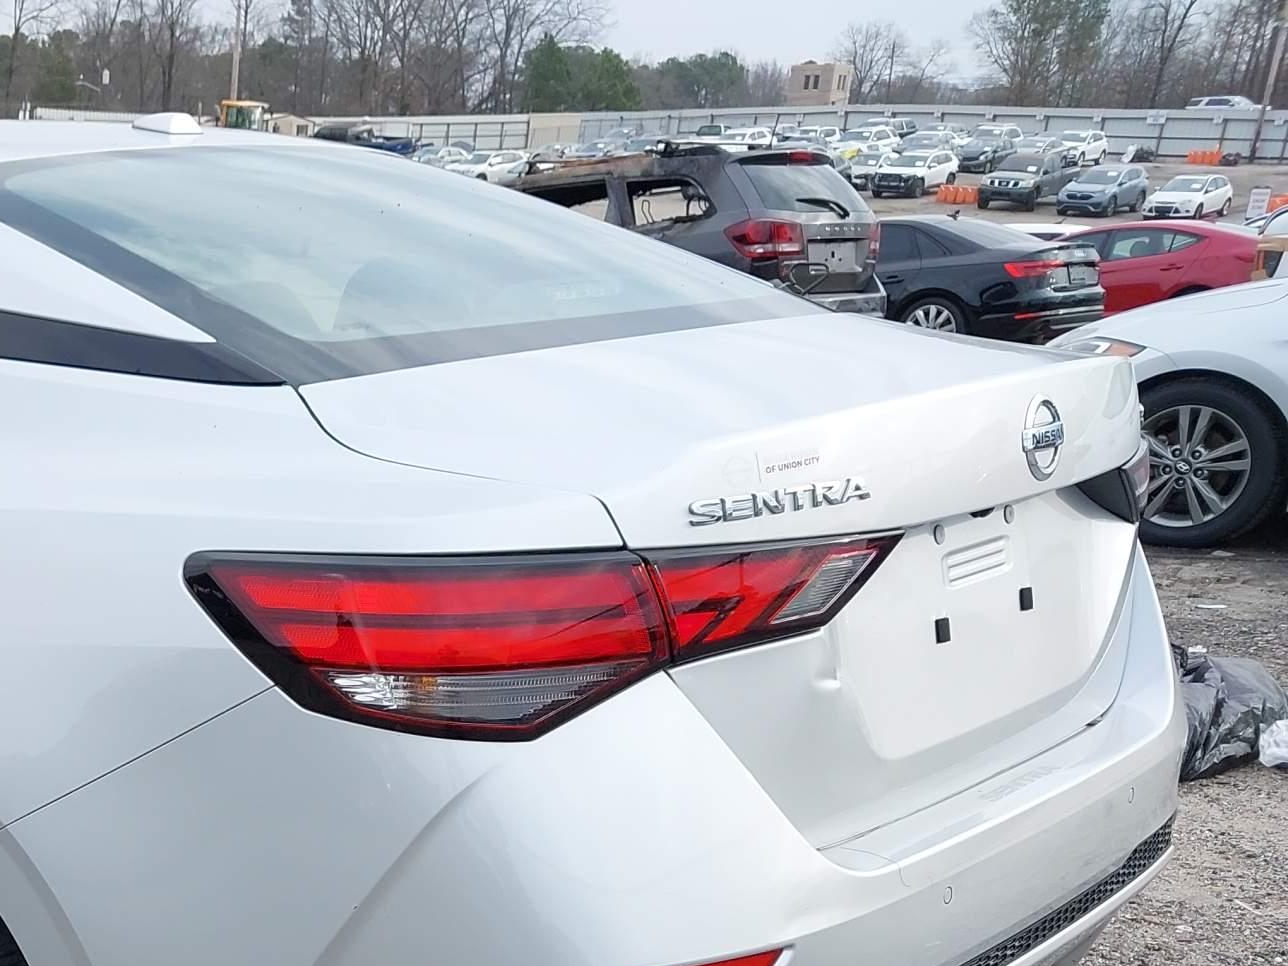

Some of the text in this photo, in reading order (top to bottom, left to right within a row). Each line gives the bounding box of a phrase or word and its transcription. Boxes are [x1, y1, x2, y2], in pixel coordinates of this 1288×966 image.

[765, 455, 820, 474] OF UNION CITY
[688, 478, 872, 527] SENTRA
